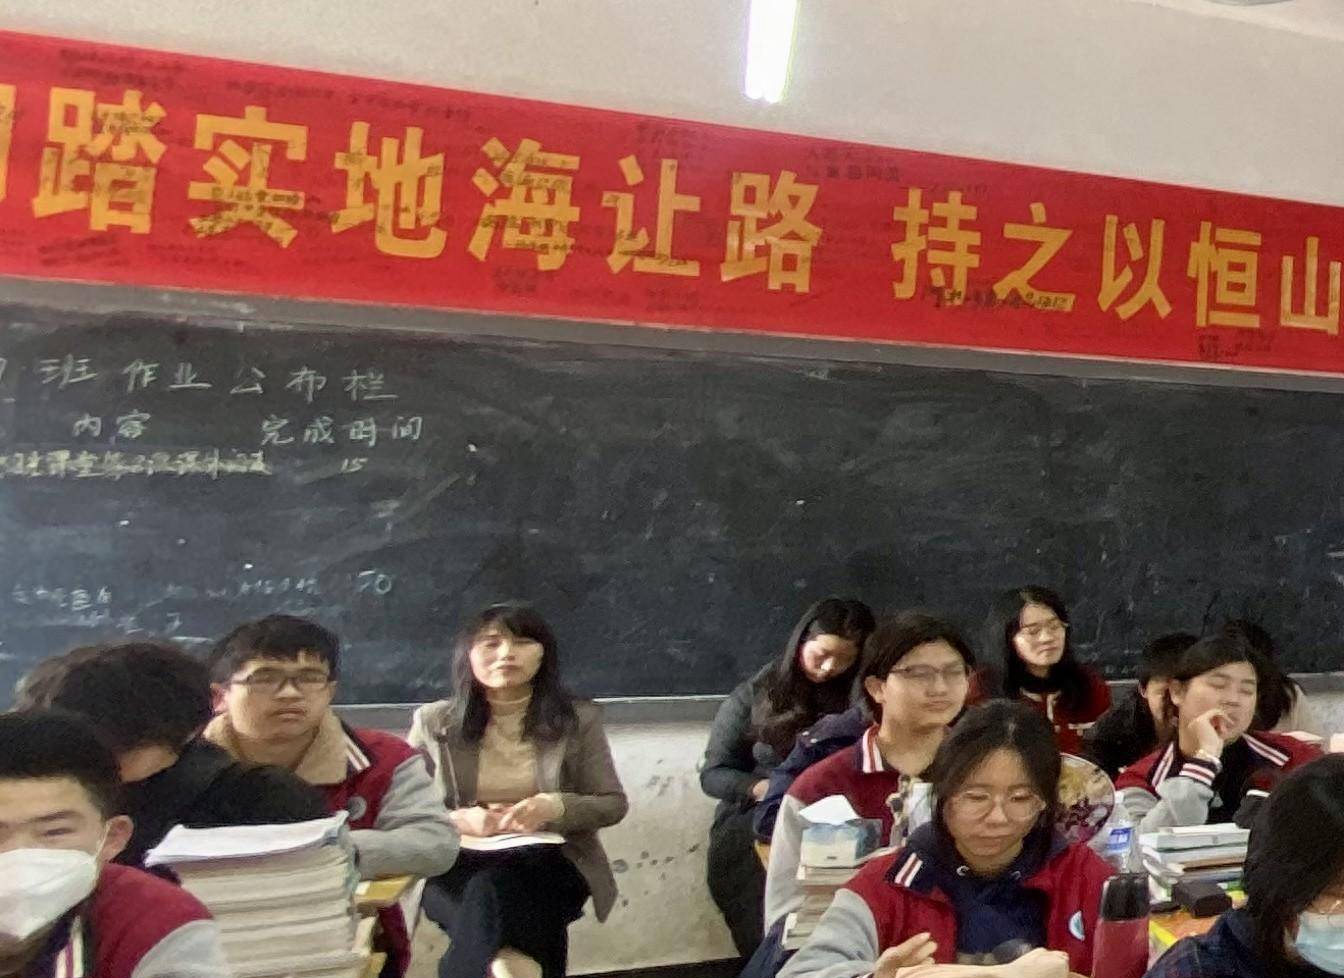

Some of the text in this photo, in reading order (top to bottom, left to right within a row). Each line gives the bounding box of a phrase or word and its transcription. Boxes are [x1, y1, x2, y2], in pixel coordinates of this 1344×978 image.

[0, 83, 822, 295] 踏实地海让路
[0, 353, 399, 403] 班作业公布栏
